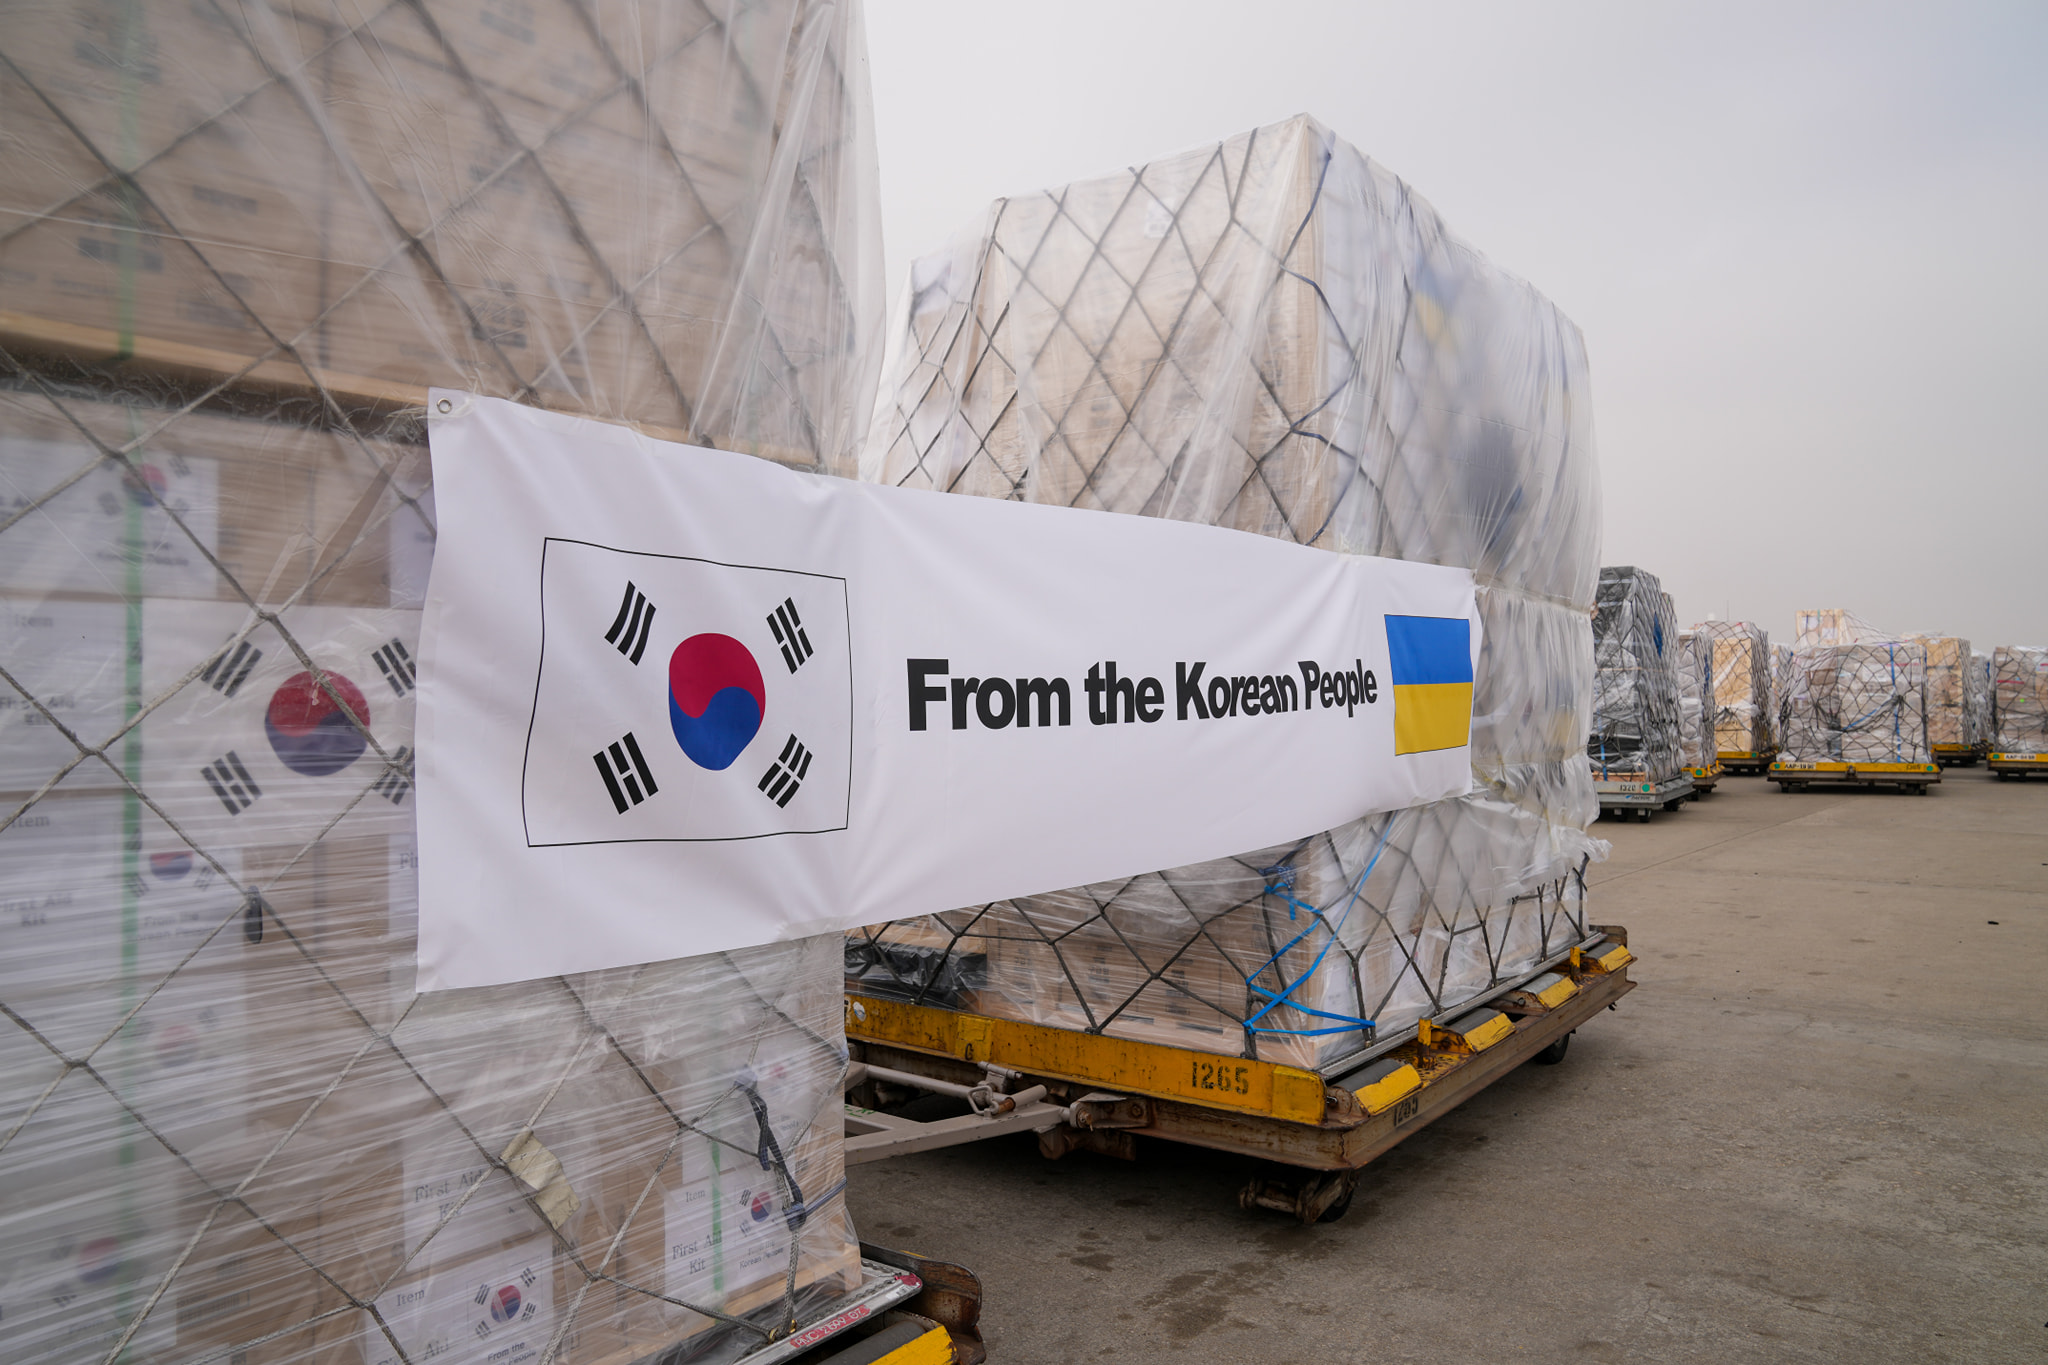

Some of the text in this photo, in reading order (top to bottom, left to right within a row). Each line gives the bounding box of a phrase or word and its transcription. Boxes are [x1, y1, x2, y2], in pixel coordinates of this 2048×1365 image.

[906, 658, 1378, 732] From the Korean People
[1190, 1061, 1250, 1096] 1265
[685, 1189, 706, 1203] Item
[672, 1241, 699, 1260] First
[689, 1258, 707, 1275] Kit
[396, 1289, 426, 1307] Item
[487, 1348, 510, 1362] From
[511, 1341, 526, 1353] the
